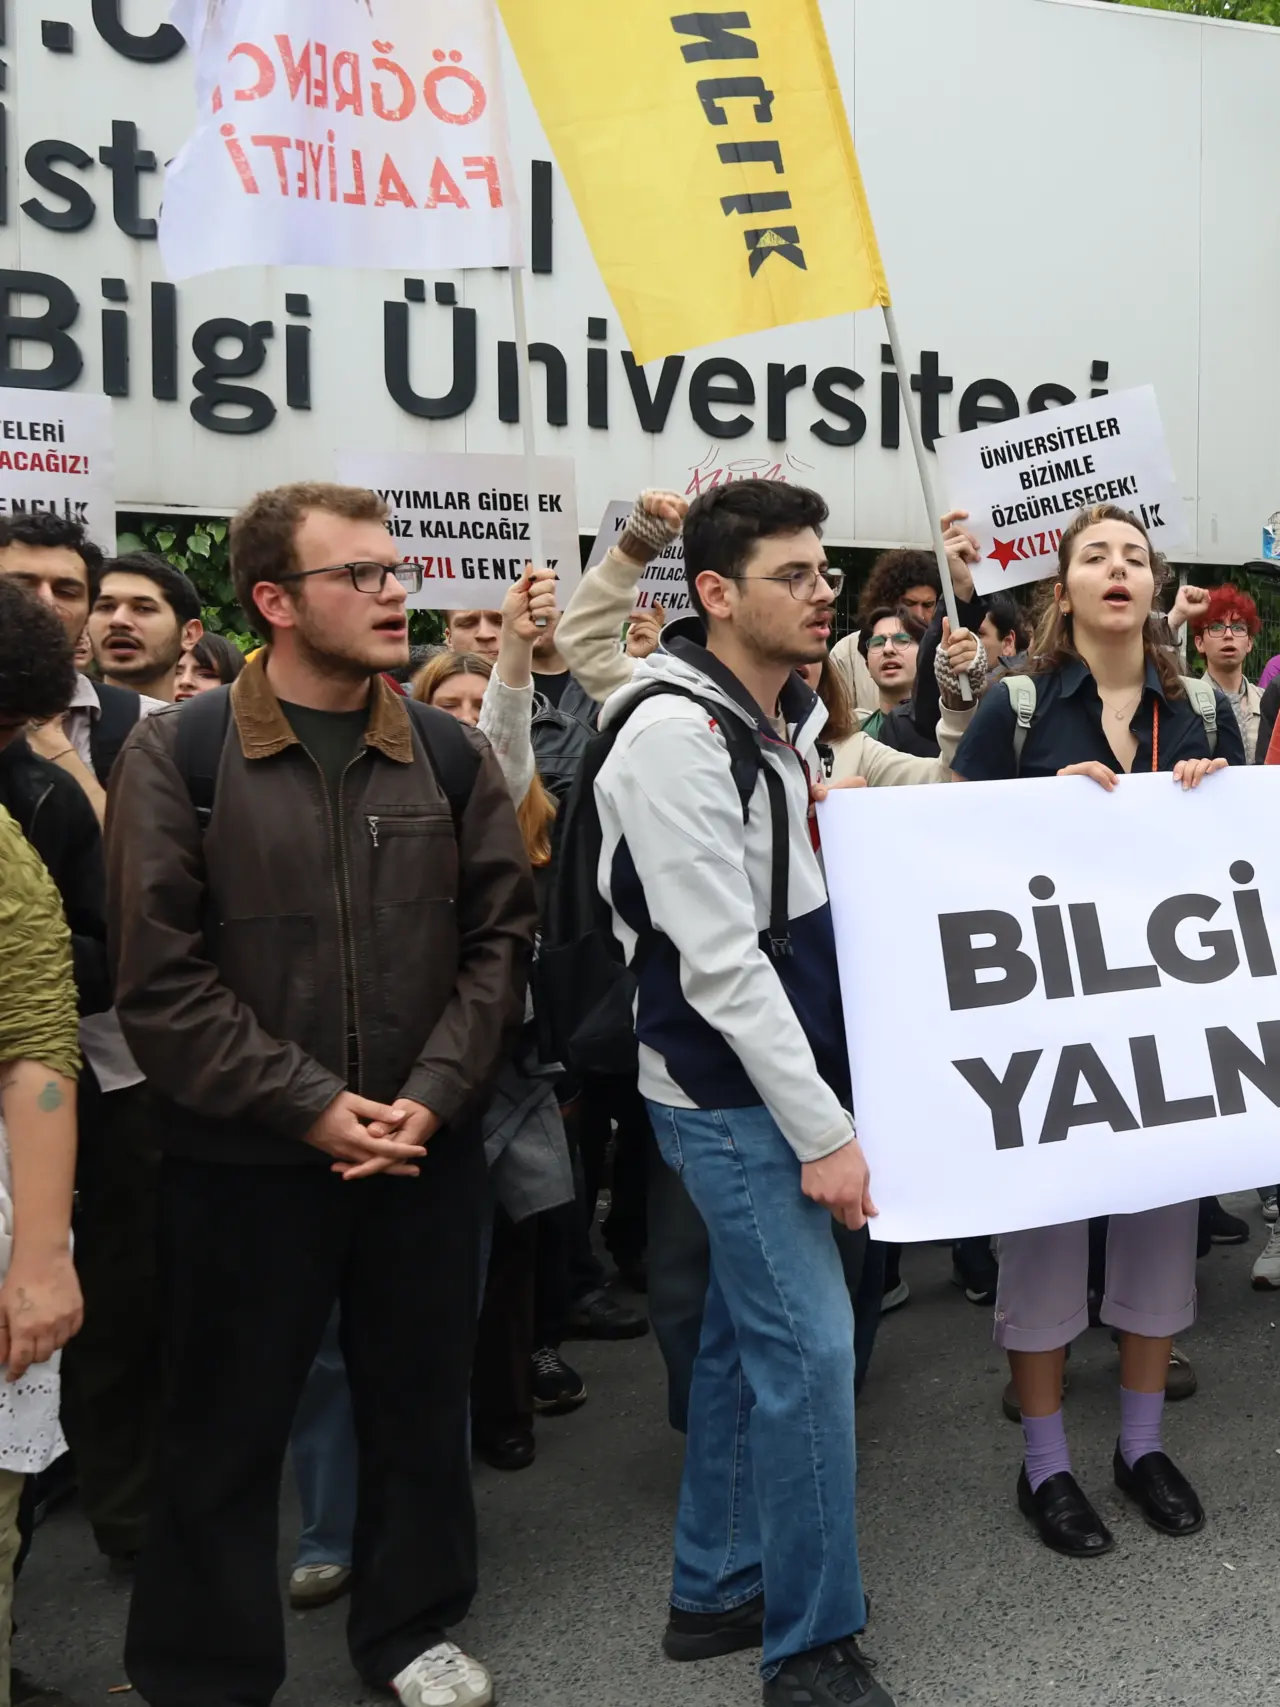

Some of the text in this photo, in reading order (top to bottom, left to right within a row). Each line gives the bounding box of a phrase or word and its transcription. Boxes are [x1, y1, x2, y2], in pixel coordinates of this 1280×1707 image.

[0, 268, 312, 434] Bilgi
[0, 419, 65, 442] ELERİ
[980, 417, 1121, 470] ÜNİVERSİTELER
[1019, 454, 1096, 490] BİZİMLE
[369, 488, 471, 510] YYIMLAR
[991, 475, 1139, 528] ÖZGÜRLEŞECEK!
[420, 517, 531, 541] KALACAĞIZ
[937, 860, 1277, 1010] BİLGİ
